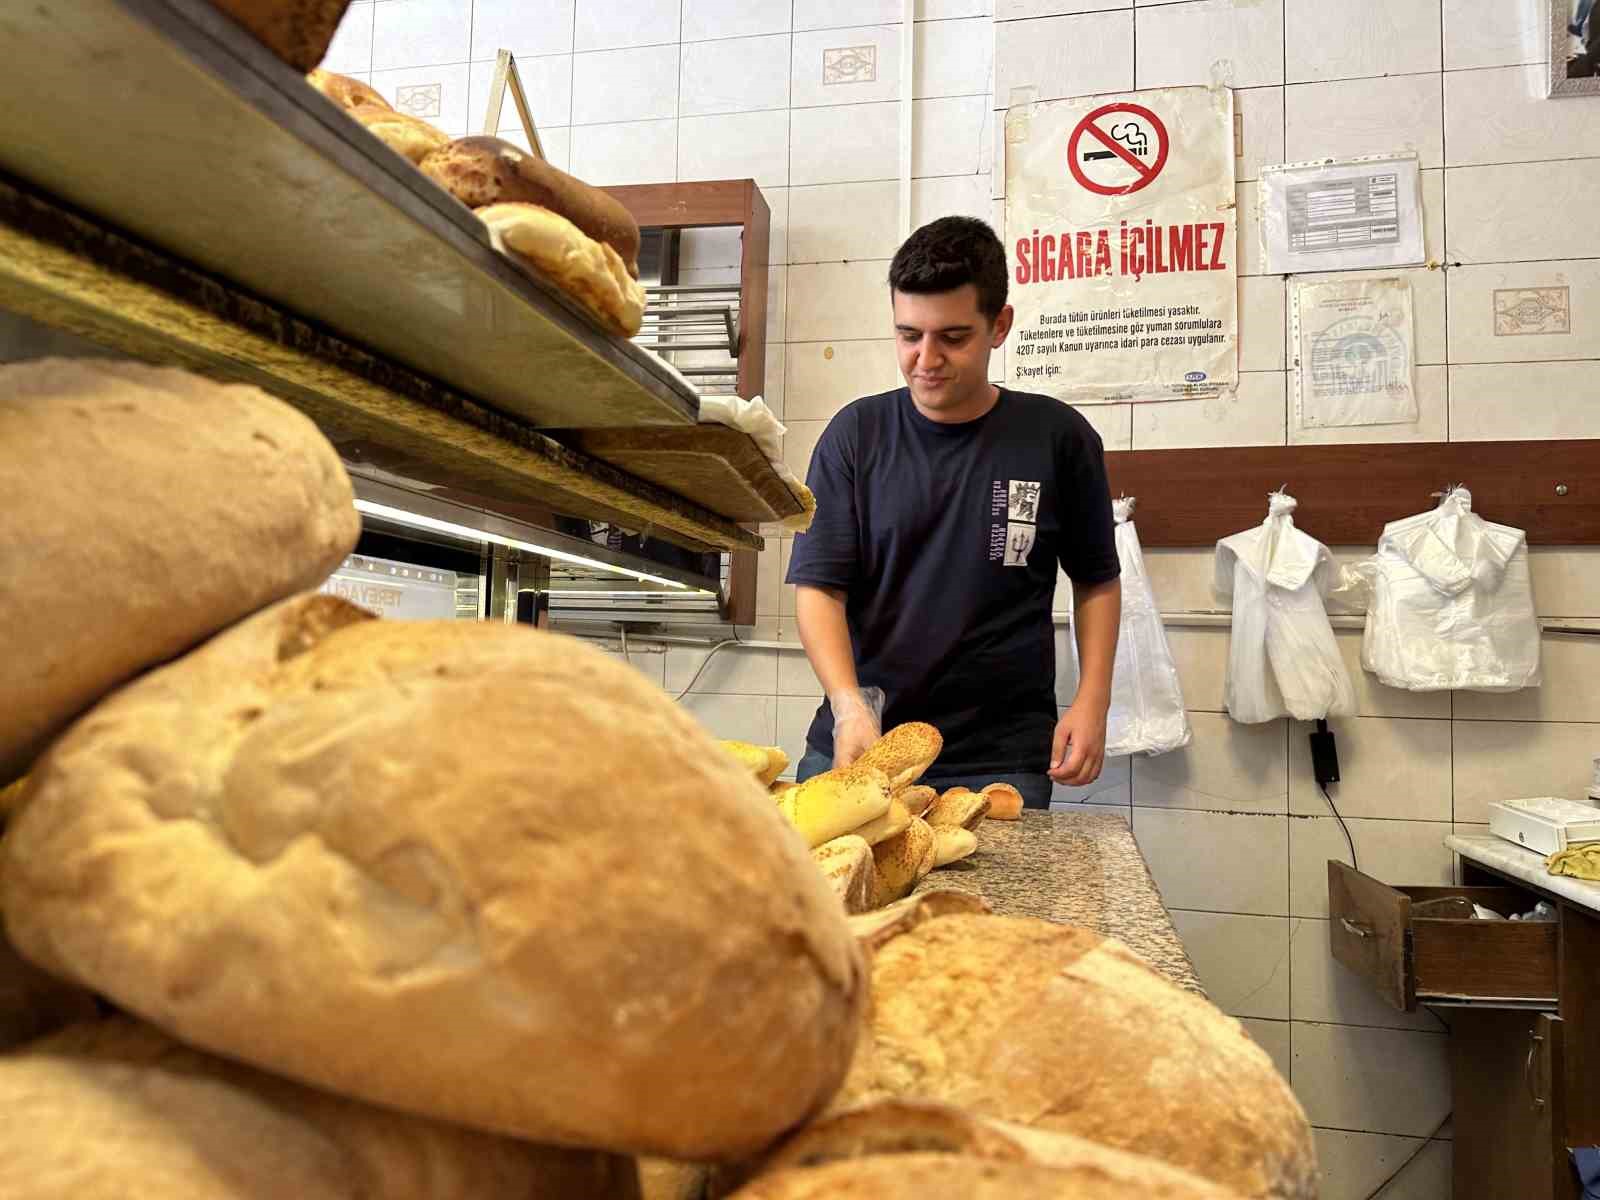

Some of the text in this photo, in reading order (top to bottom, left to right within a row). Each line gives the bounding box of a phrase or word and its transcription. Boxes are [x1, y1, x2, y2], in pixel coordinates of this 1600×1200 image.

[1015, 218, 1226, 284] SİGARA İÇİLMEZ
[1040, 305, 1200, 325] Burada tütün ürünleri tüketilmesi yasaktır.
[1019, 318, 1222, 341] Tüketenlere ve tüketilmesine göz yuman sorumlulara
[1016, 334, 1226, 356] 4207 sayılı Kanun uyarınca idari para cezası uygulanır.
